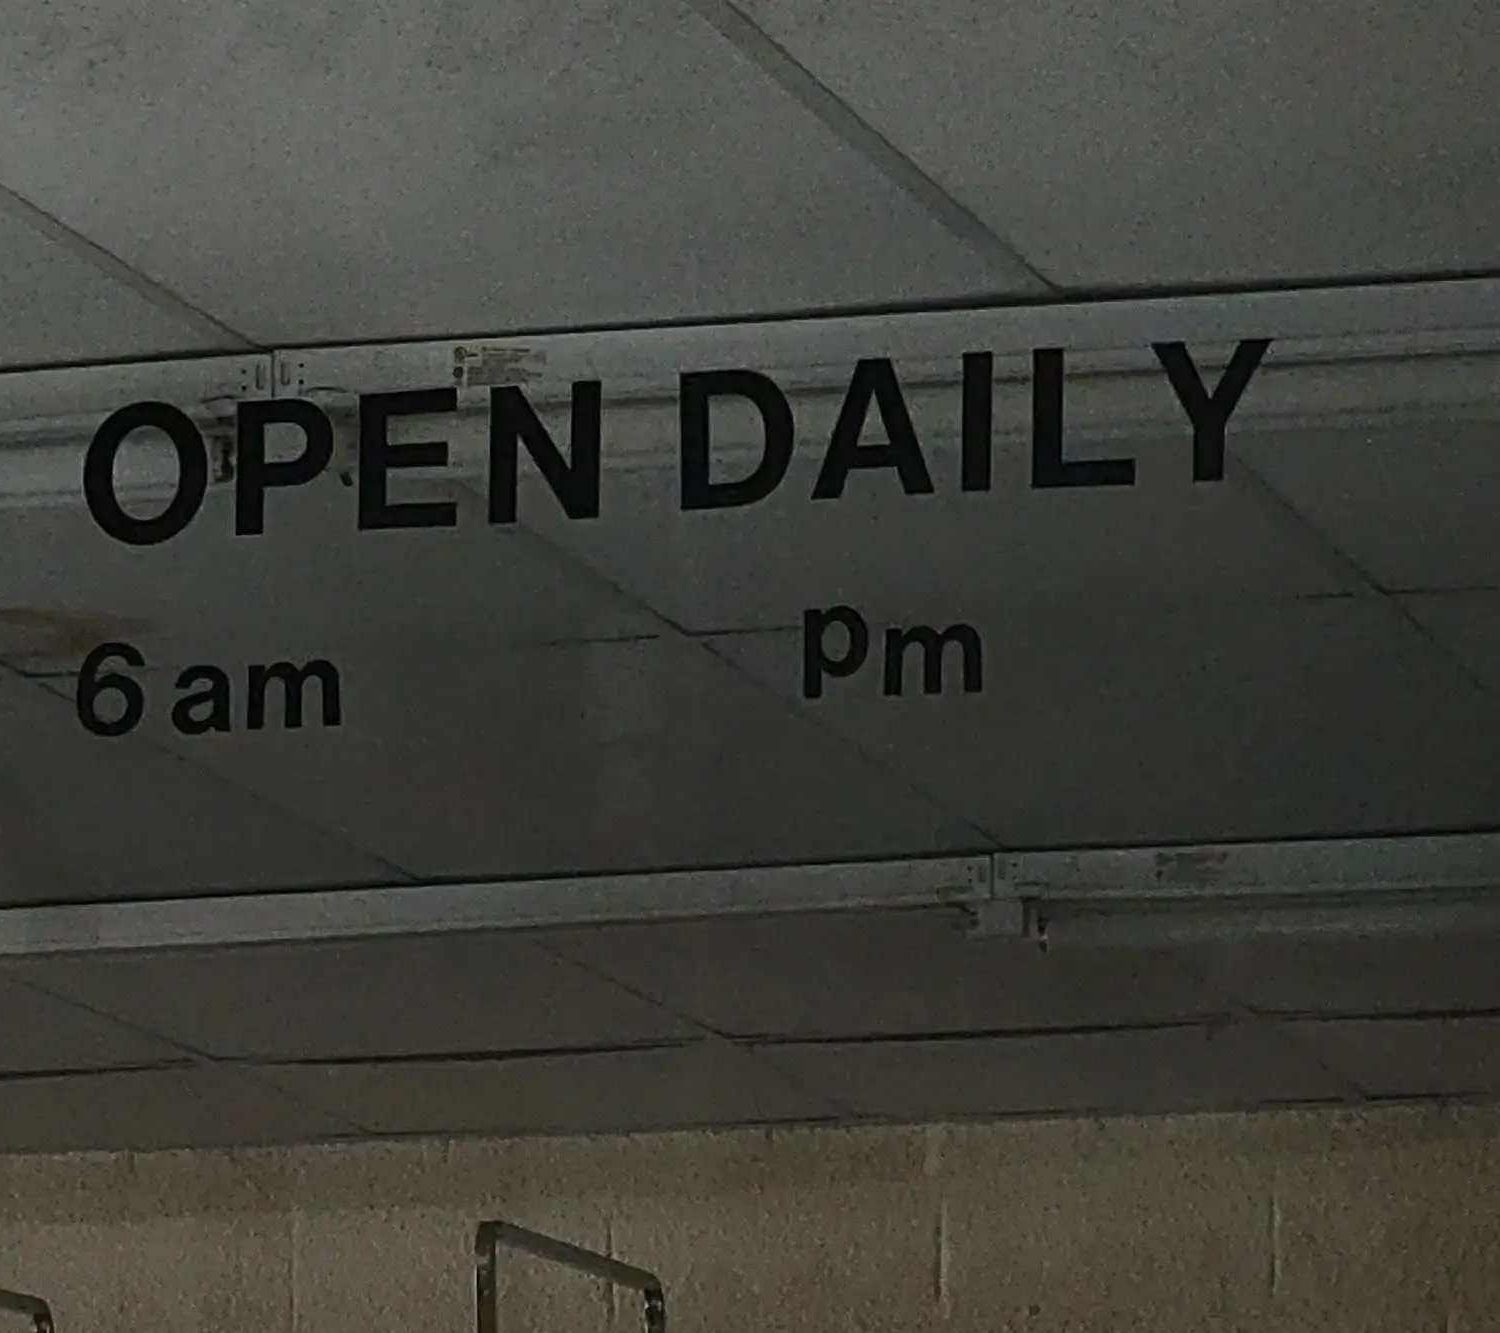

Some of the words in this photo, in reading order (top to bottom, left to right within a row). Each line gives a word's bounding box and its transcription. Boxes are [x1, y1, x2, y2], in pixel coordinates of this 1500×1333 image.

[83, 380, 602, 546] OPEN
[680, 338, 1274, 511] DAILY
[803, 605, 984, 700] pm
